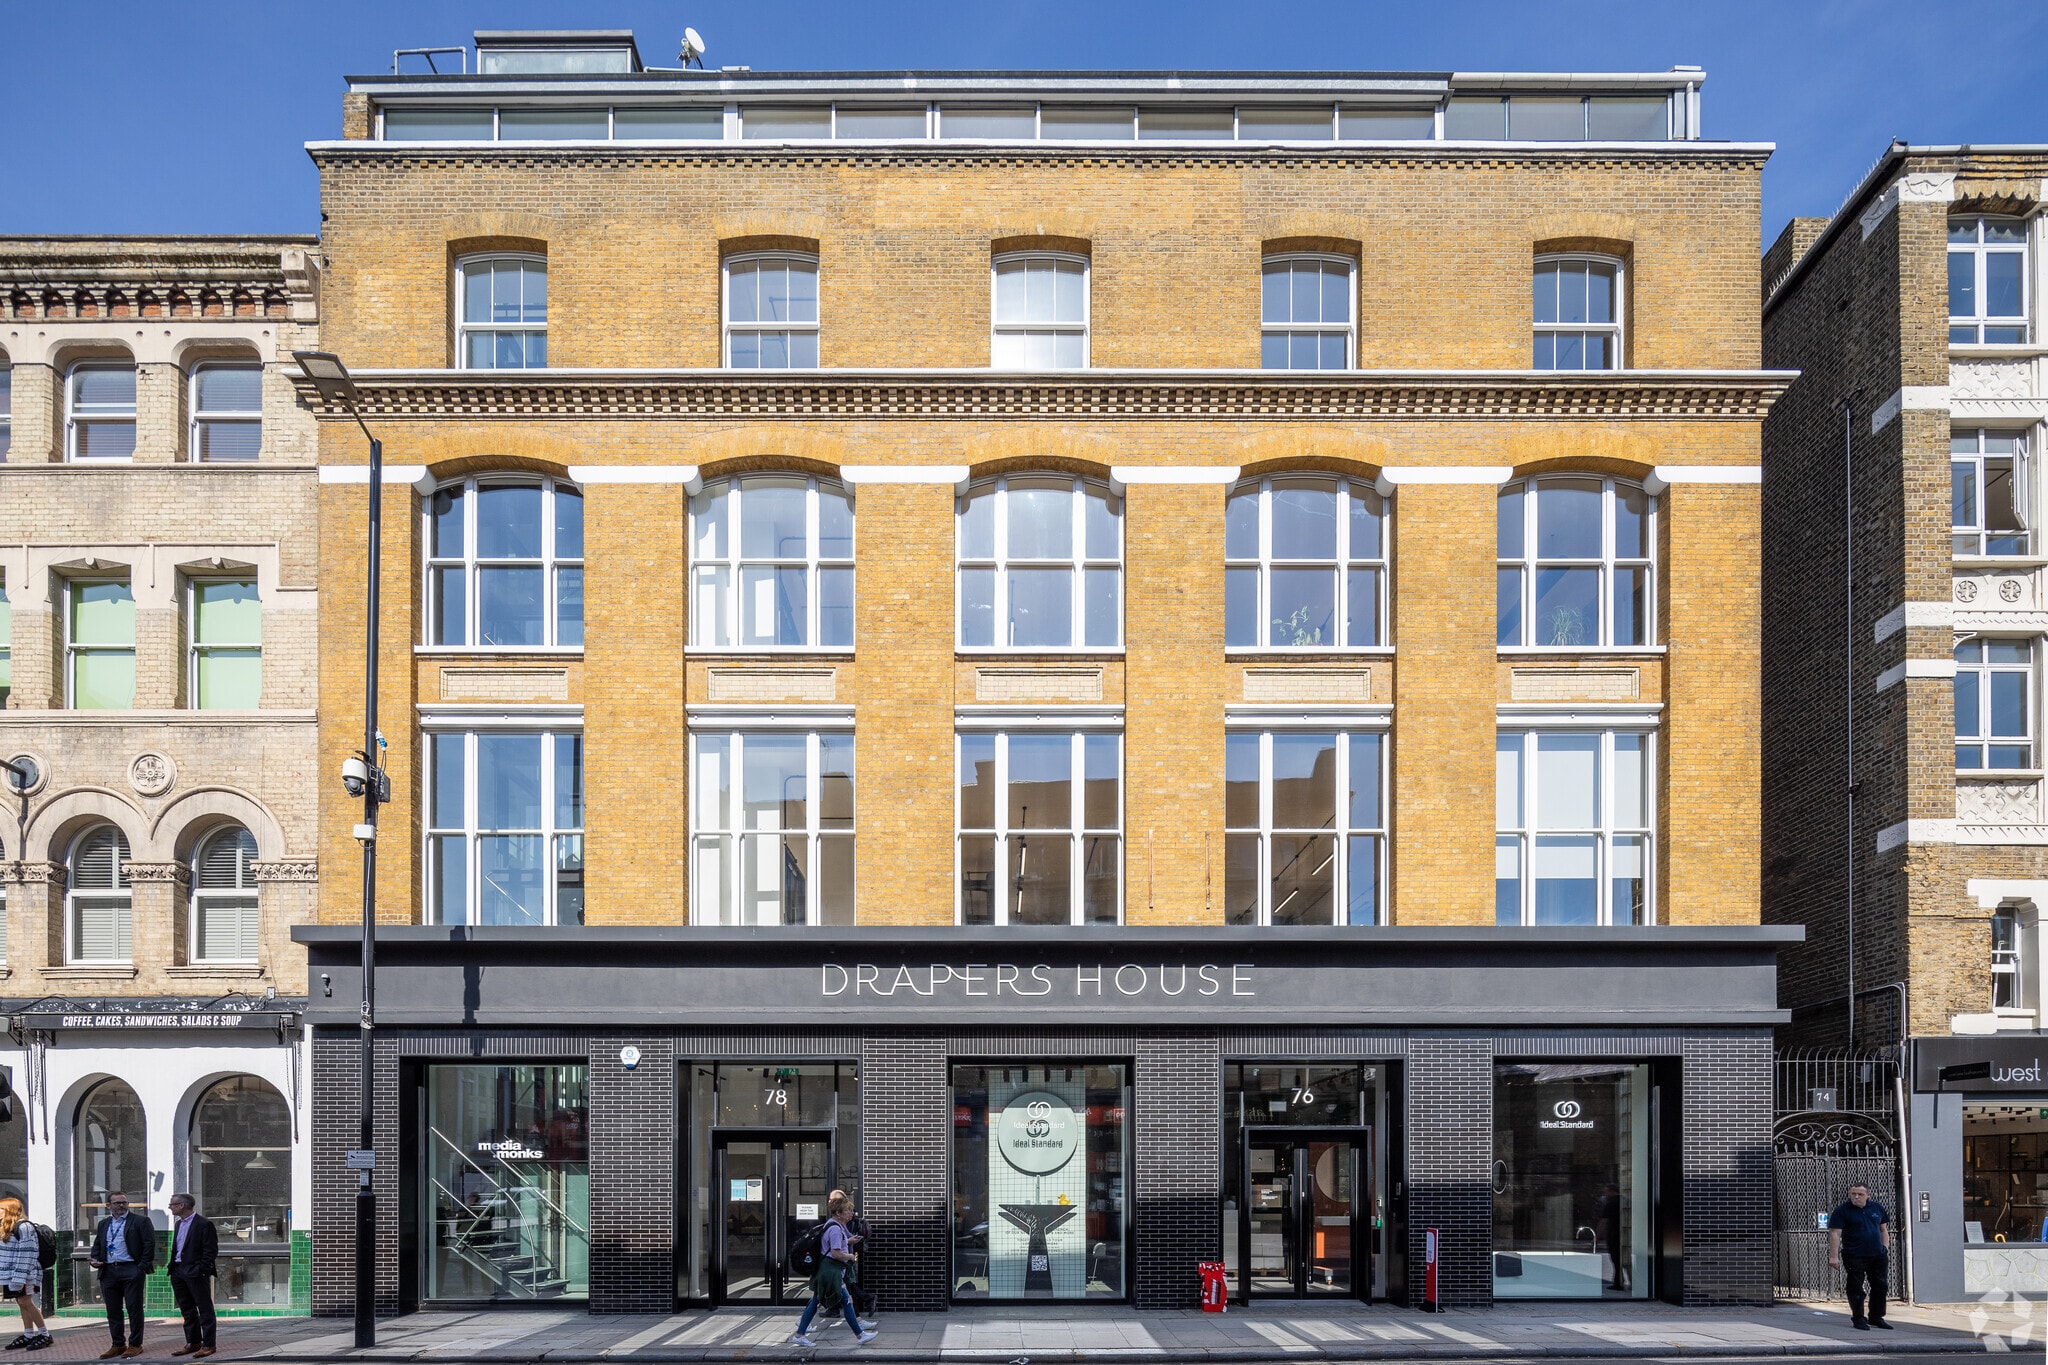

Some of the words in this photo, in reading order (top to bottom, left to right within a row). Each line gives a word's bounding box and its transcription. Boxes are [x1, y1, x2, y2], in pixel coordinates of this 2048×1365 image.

[822, 963, 1052, 996] DRAPERS
[1077, 963, 1255, 996] HOUSE
[62, 1015, 94, 1027] COFFEE,
[95, 1015, 123, 1027] CAKES,
[124, 1015, 180, 1027] SANDWICHES,
[181, 1015, 212, 1027] SALADS
[213, 1015, 218, 1026] &
[220, 1015, 242, 1026] SOUP
[1991, 1058, 2041, 1082] west
[764, 1088, 787, 1105] 78
[1291, 1087, 1314, 1104] 76
[1816, 1092, 1830, 1102] 74
[1559, 1120, 1594, 1129] Standard
[478, 1140, 521, 1151] media
[1012, 1139, 1030, 1148] Ideal
[1031, 1139, 1063, 1149] Standard
